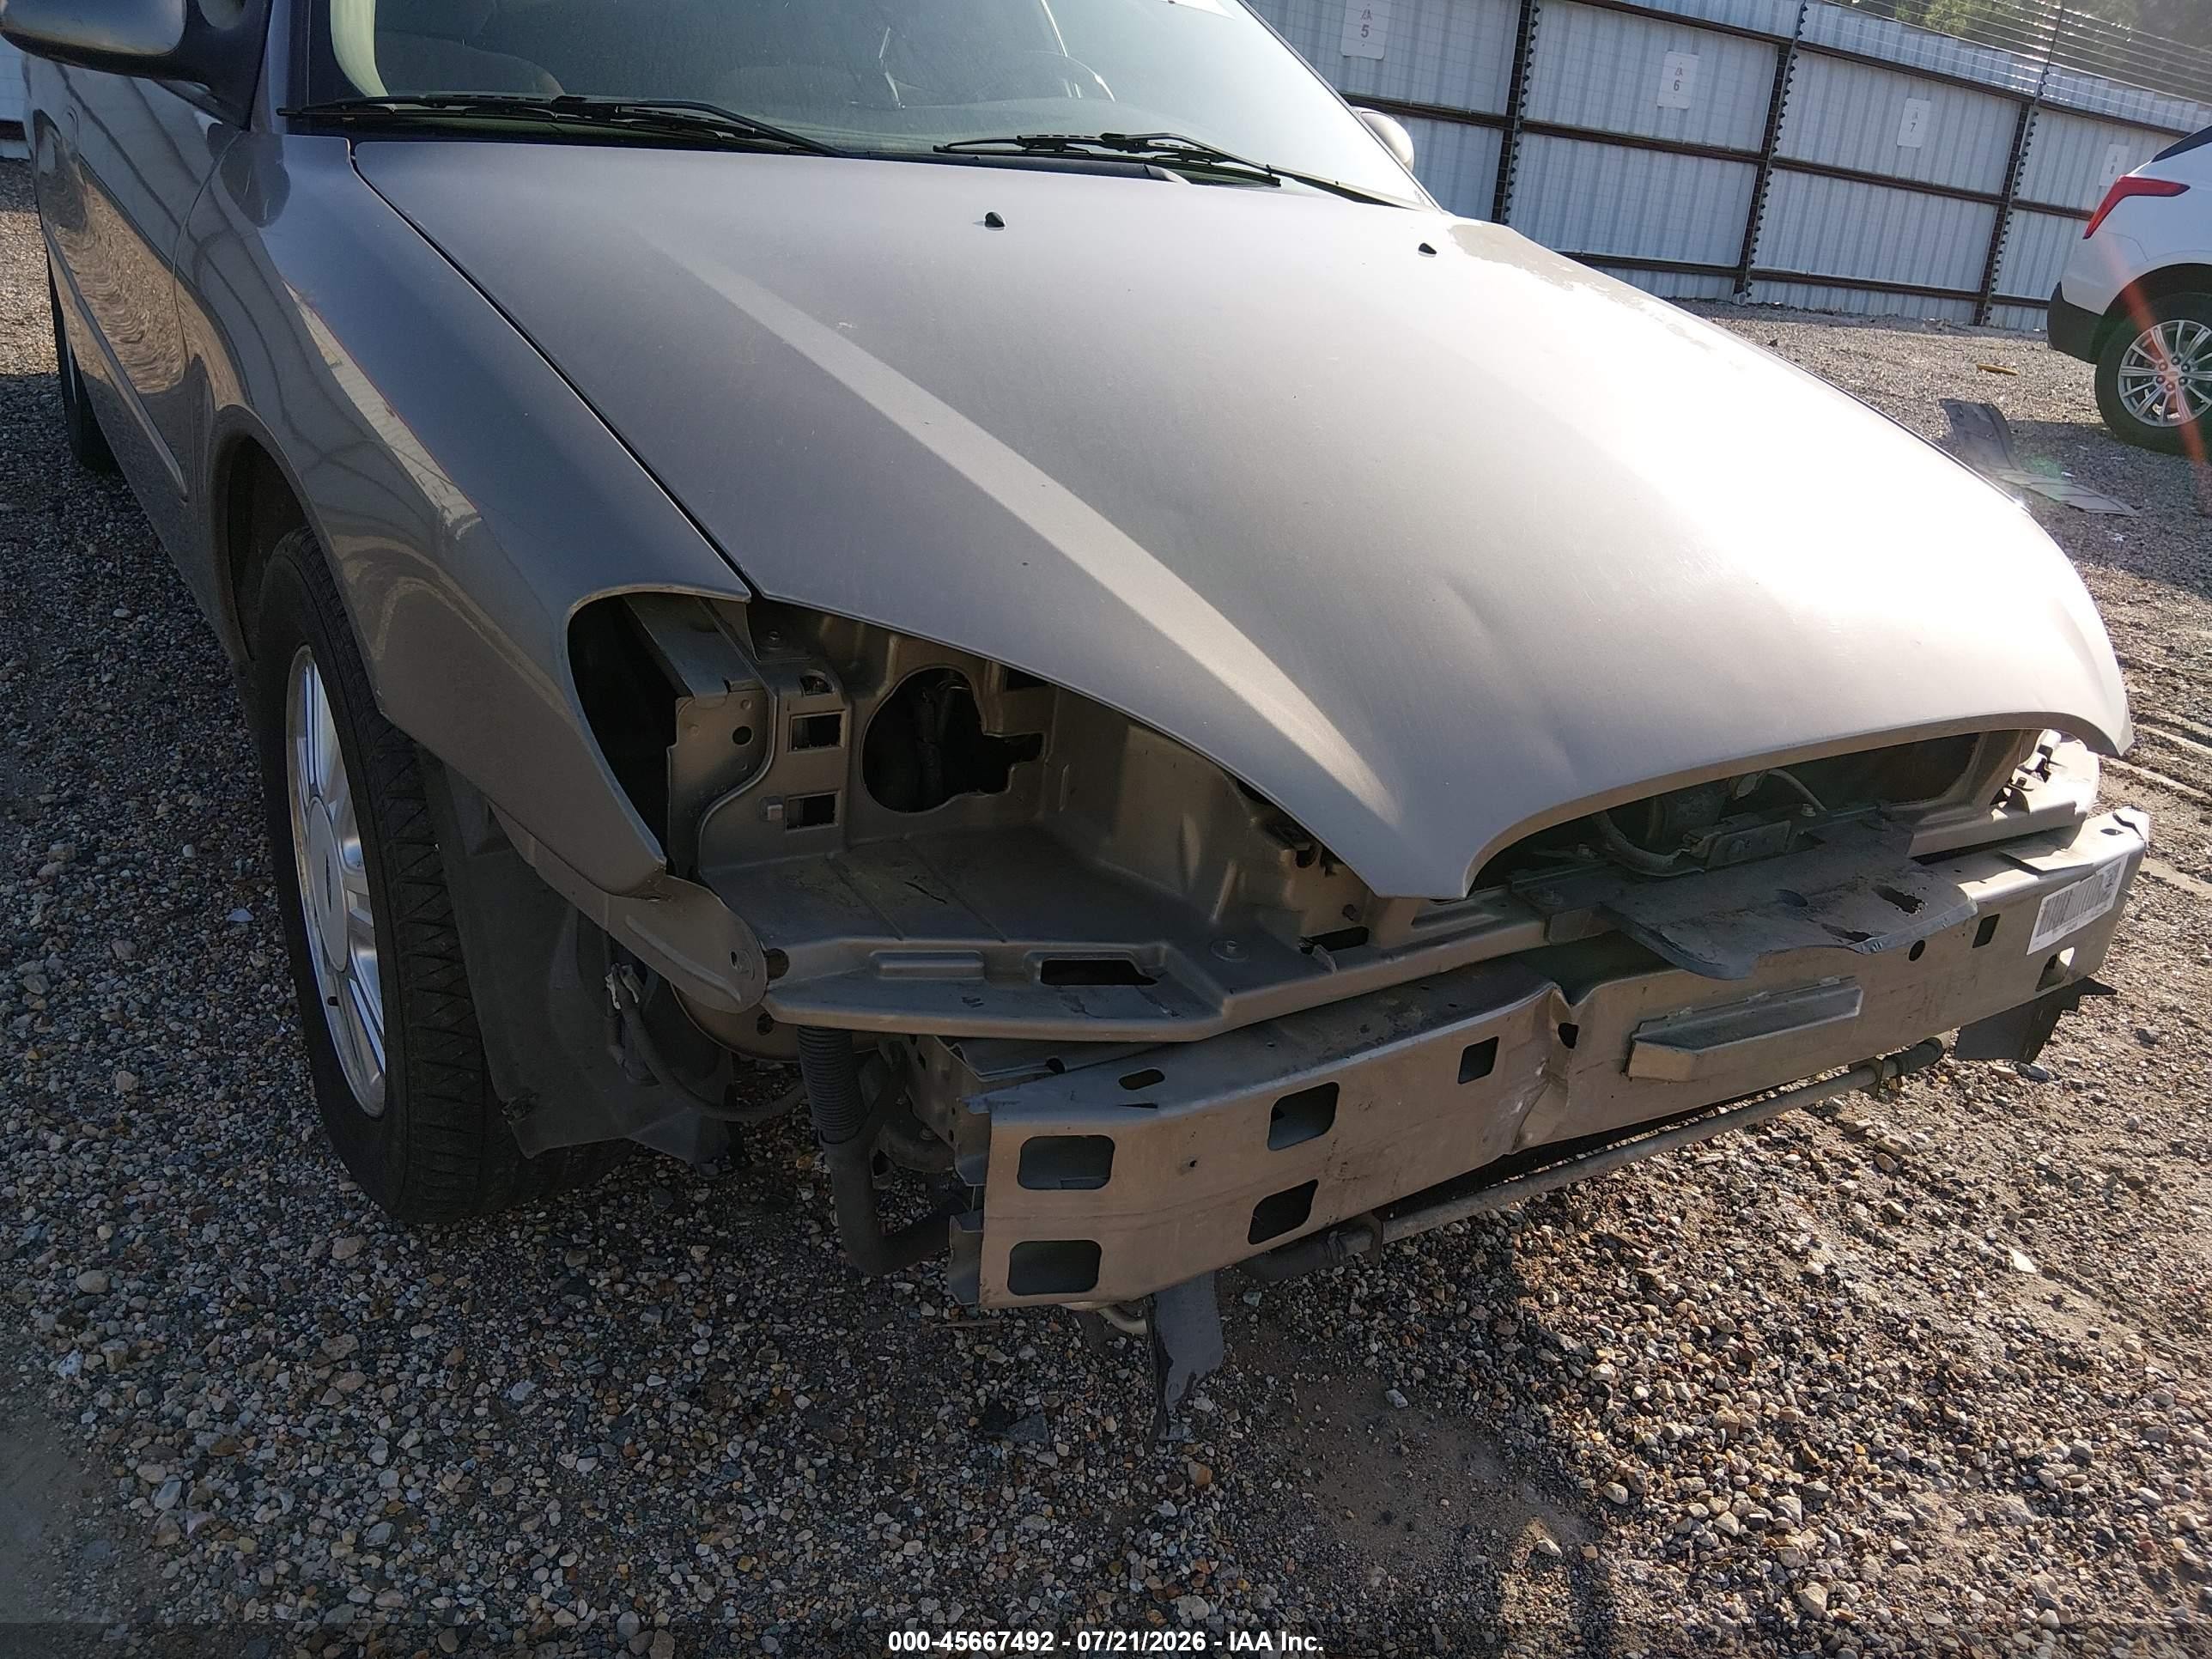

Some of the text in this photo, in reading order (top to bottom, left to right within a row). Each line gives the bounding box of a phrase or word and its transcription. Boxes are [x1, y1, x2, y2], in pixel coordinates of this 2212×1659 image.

[1360, 24, 1370, 39] 5
[1674, 80, 1680, 91] 6
[1911, 122, 1917, 132] 7
